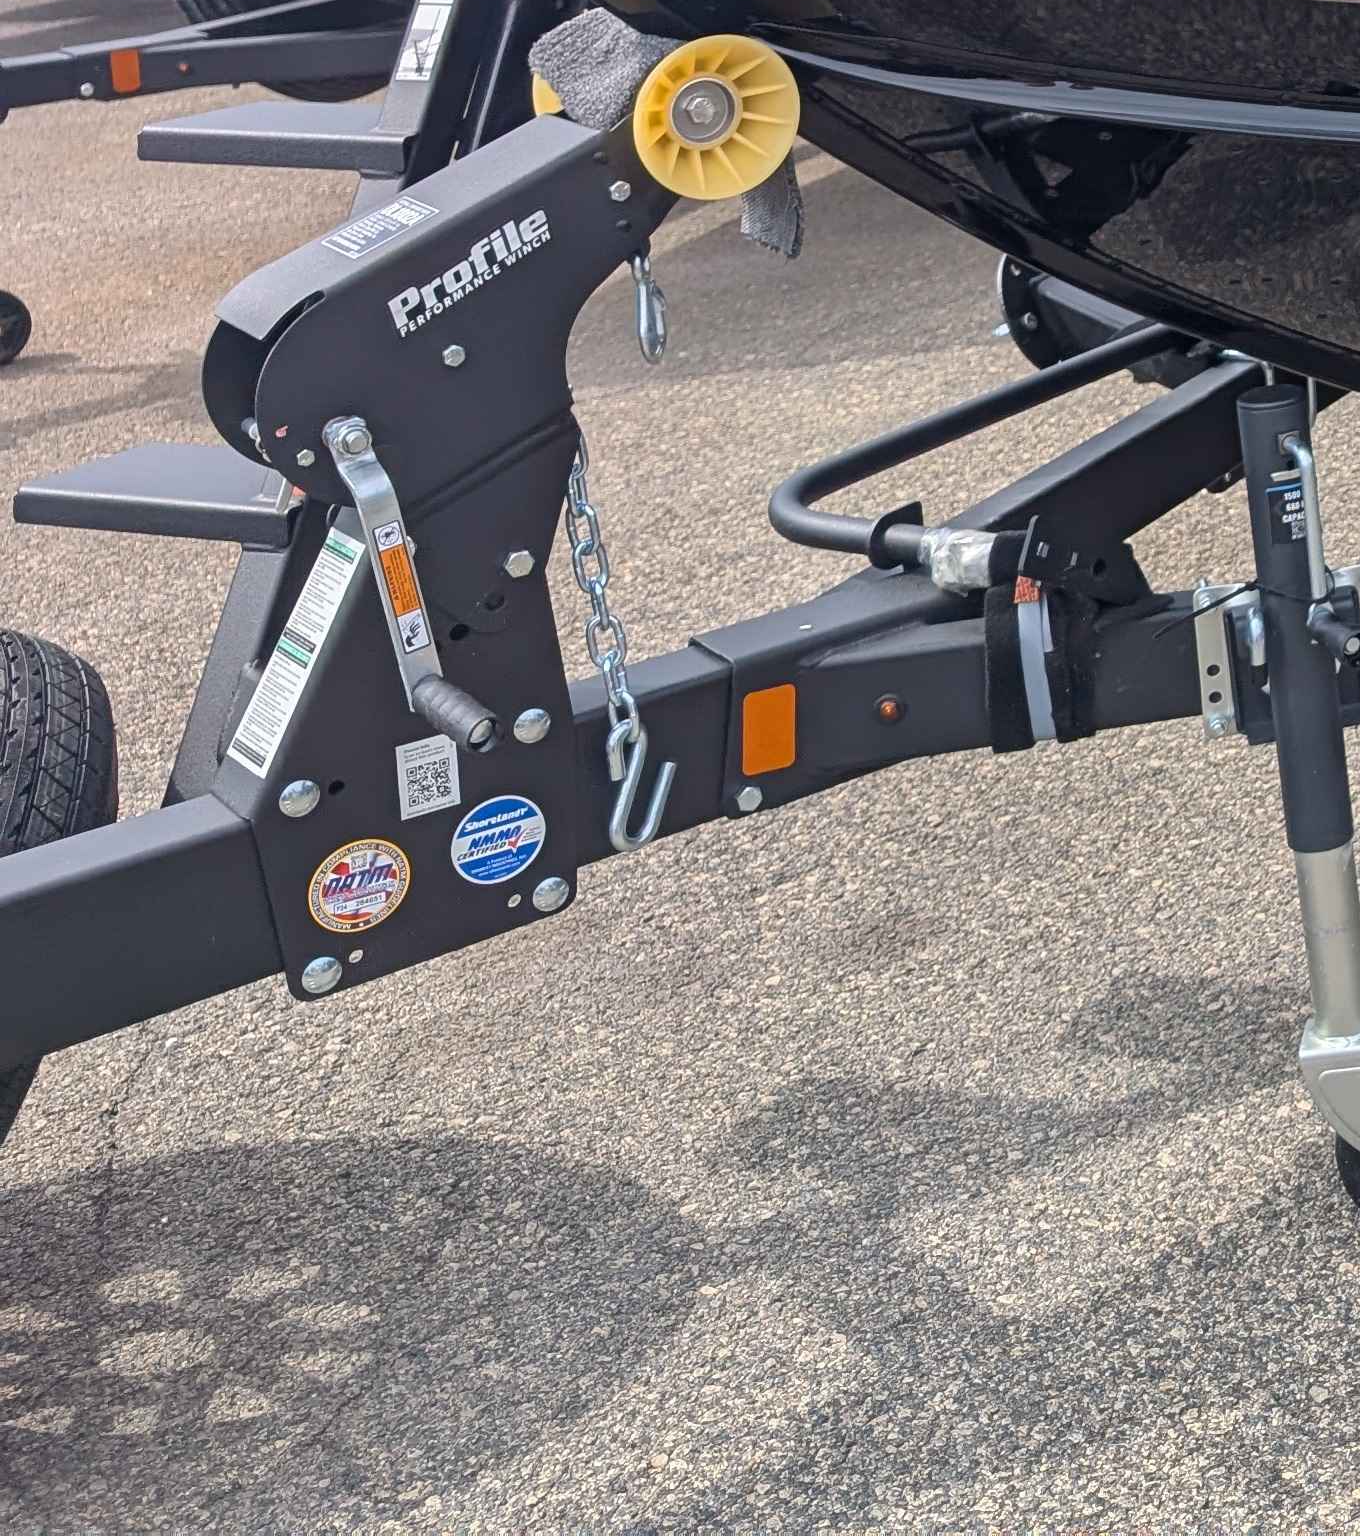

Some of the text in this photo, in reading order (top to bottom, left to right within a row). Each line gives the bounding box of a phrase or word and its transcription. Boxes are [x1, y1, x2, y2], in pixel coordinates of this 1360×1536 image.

[387, 209, 549, 329] Profile
[400, 230, 552, 338] PERFORMANCE WINCH
[457, 841, 507, 862] CERTIFIED
[468, 825, 522, 850] NMMA
